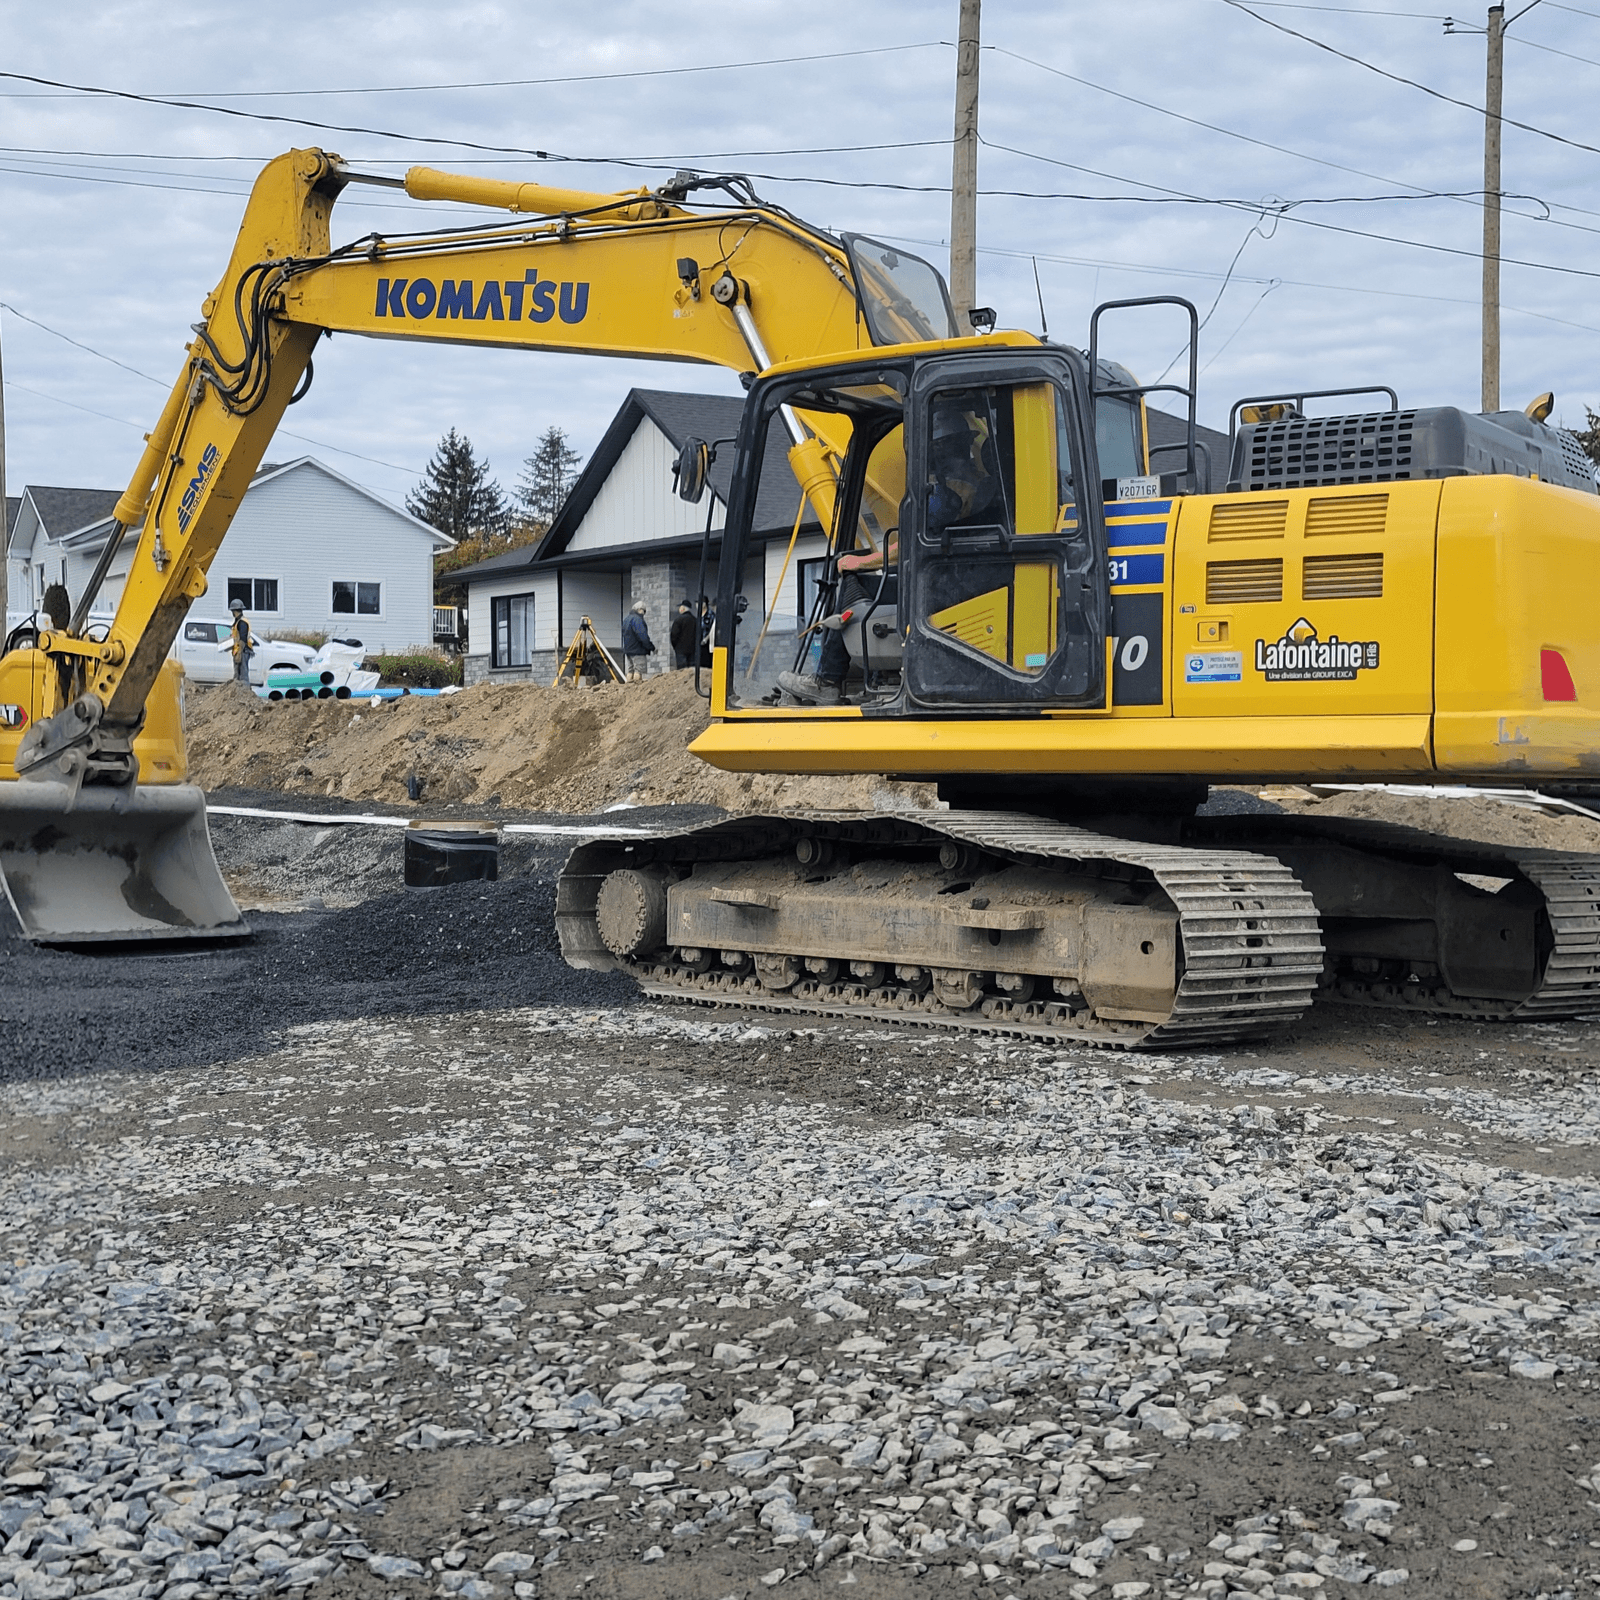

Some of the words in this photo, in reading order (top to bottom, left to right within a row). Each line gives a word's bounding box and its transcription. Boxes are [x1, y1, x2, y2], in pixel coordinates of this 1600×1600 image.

[375, 268, 590, 324] KOMATSU
[181, 442, 217, 511] SMS
[189, 450, 221, 515] EQUIPMENT
[1257, 637, 1362, 670] Lafontaine
[1367, 643, 1377, 657] Fils
[1367, 657, 1377, 667] et
[1281, 671, 1302, 679] division
